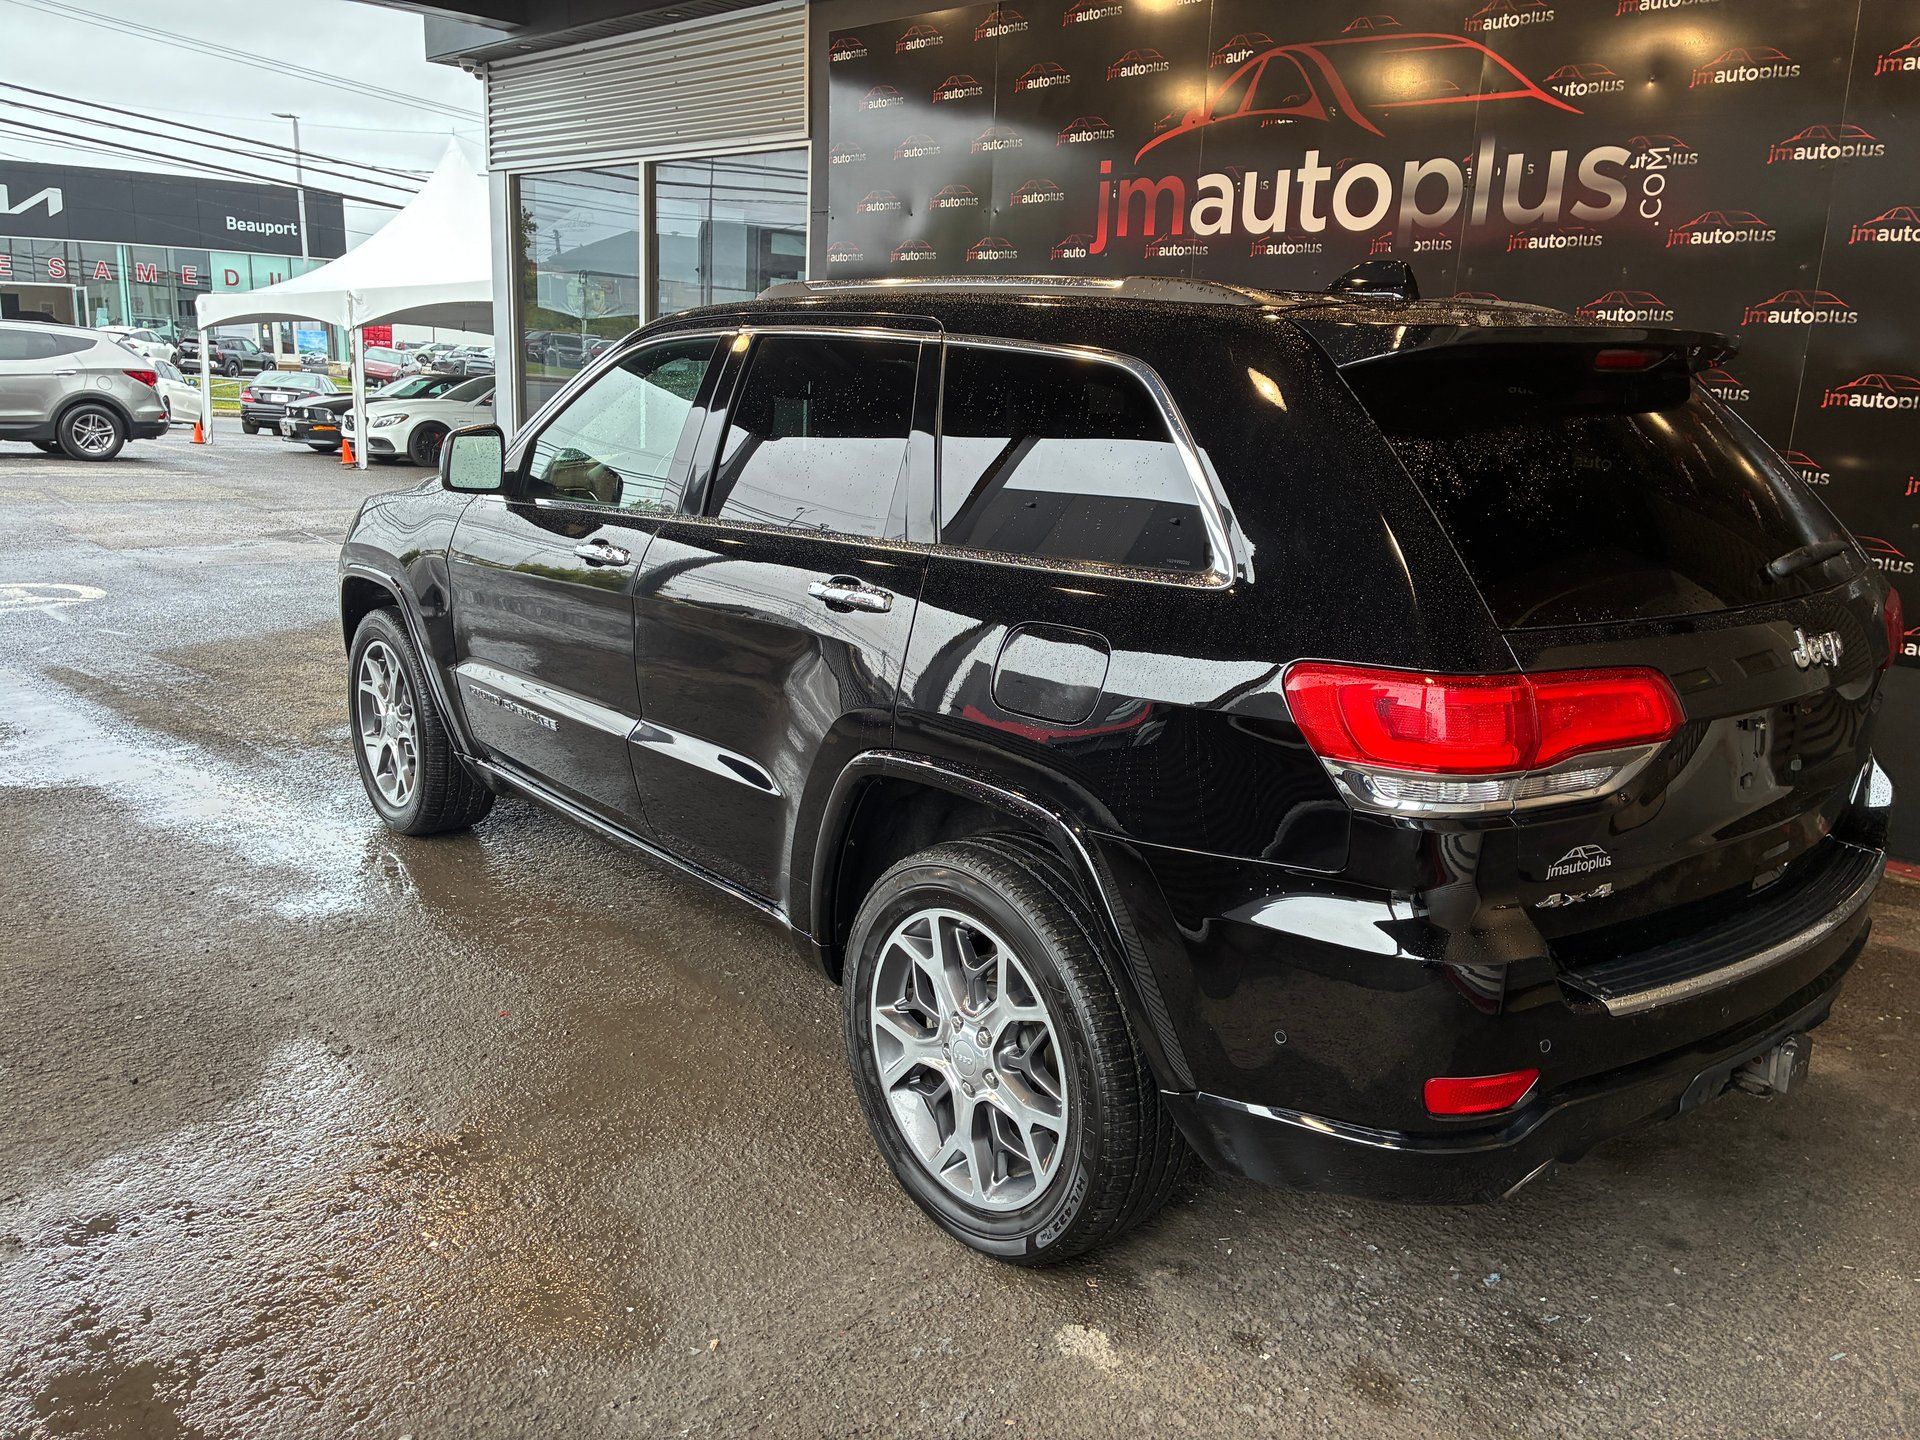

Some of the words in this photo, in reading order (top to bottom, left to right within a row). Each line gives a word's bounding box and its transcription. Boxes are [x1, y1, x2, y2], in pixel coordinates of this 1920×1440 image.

[1062, 5, 1123, 27] jmautoplus
[974, 21, 1029, 42] jmautoplus
[895, 35, 944, 54] jmautoplus
[1106, 60, 1169, 82] jmautoplus
[1689, 62, 1800, 89] jmautoplus
[1014, 74, 1071, 94] jmautoplus
[932, 86, 983, 104] jmautoplus
[1057, 128, 1115, 147] jmautoplus
[1767, 142, 1885, 165] jmautoplus
[929, 197, 979, 211] jmautoplus
[1010, 191, 1065, 207] jmautoplus
[1089, 136, 1631, 255] jmautoplus
[225, 215, 298, 236] Beauport
[1506, 233, 1603, 252] jmautoplus
[1666, 227, 1777, 248] jmautoplus
[890, 249, 937, 263] jmautoplus
[965, 248, 1018, 262] jmautoplus
[1144, 244, 1209, 259] jmautoplus
[1249, 241, 1323, 258] jmautoplus
[1741, 306, 1858, 326] jmautoplus
[1791, 626, 1844, 669] Jeep
[1545, 854, 1612, 880] jmautoplus
